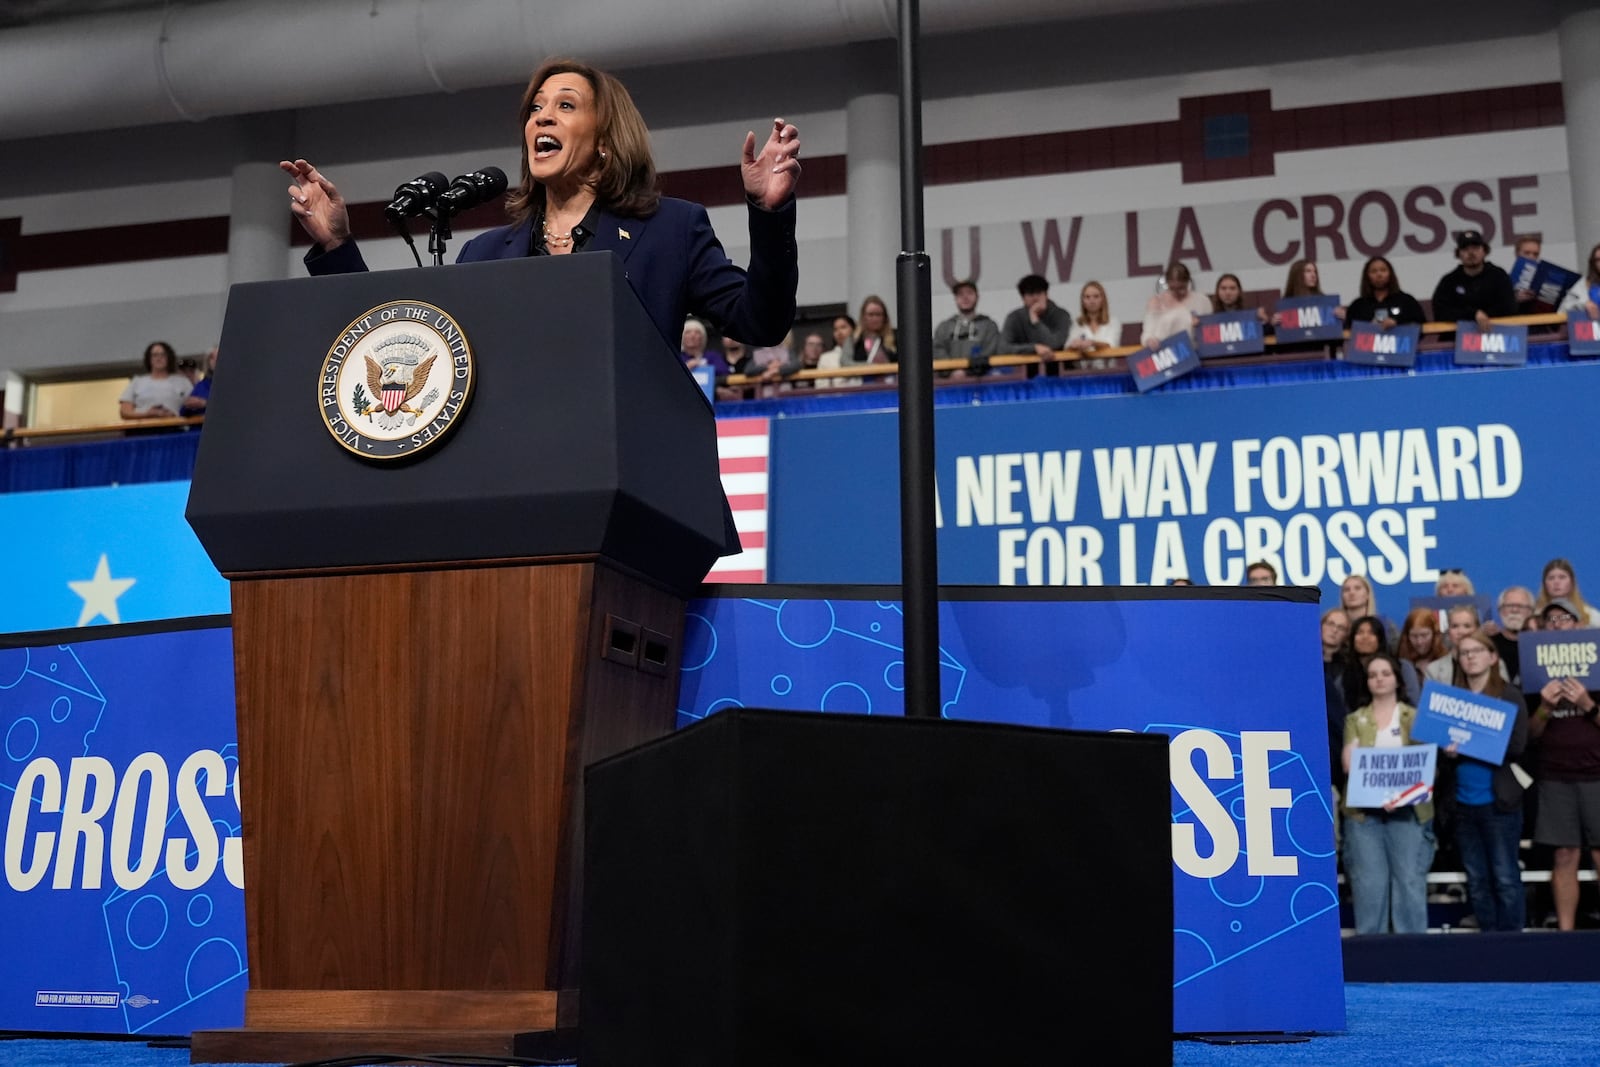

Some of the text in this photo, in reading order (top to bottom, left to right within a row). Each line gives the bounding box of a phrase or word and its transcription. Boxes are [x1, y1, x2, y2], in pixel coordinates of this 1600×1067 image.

[941, 175, 1542, 287] U W LA CROSSE
[323, 307, 468, 449] VICE PRESIDENT OF THE UNITED STATES
[955, 449, 1081, 527] NEW
[1093, 441, 1217, 520] WAY
[1232, 423, 1522, 513] FORWARD
[998, 506, 1440, 587] FOR LA CROSSE
[1536, 642, 1598, 666] HARRIS
[1546, 663, 1590, 678] WALZ
[1428, 691, 1507, 731] WISCONSIN
[1359, 751, 1429, 769] A NEW WAY
[1362, 770, 1422, 788] FORWARD
[4, 749, 246, 892] CROS
[1108, 729, 1299, 879] SE
[49, 994, 58, 1003] FOR
